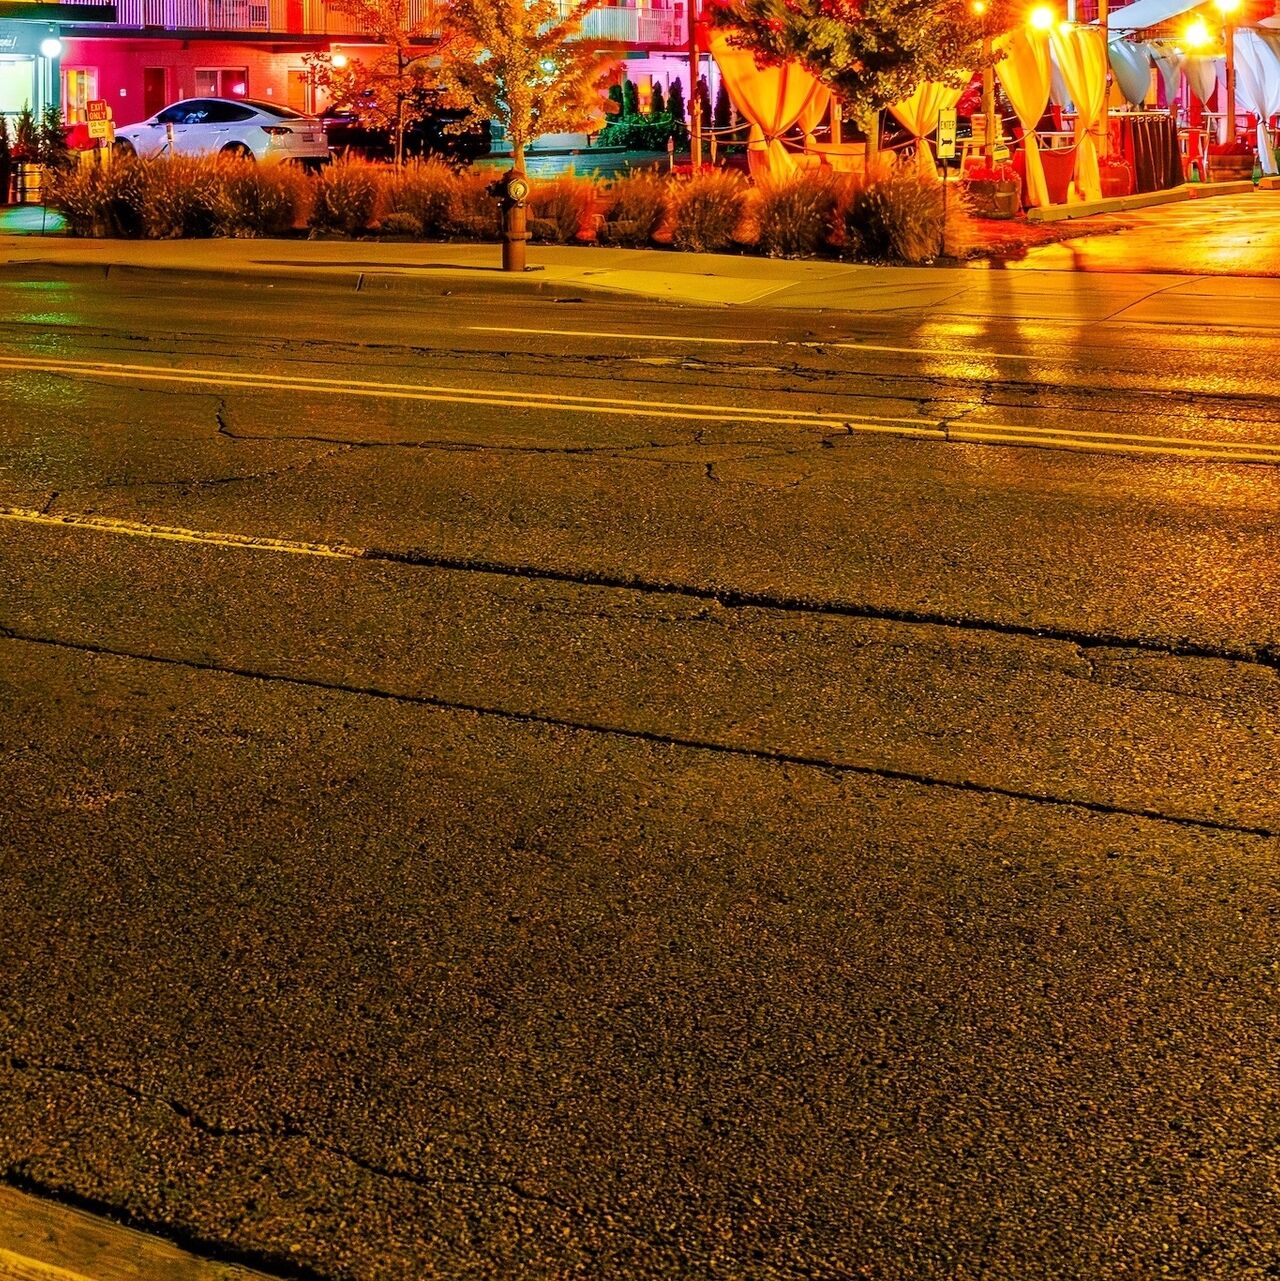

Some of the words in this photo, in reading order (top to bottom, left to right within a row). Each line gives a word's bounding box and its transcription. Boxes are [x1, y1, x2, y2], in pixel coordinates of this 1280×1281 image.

[90, 102, 104, 111] EXIT
[89, 111, 106, 120] ONLY
[940, 120, 955, 130] ENTER
